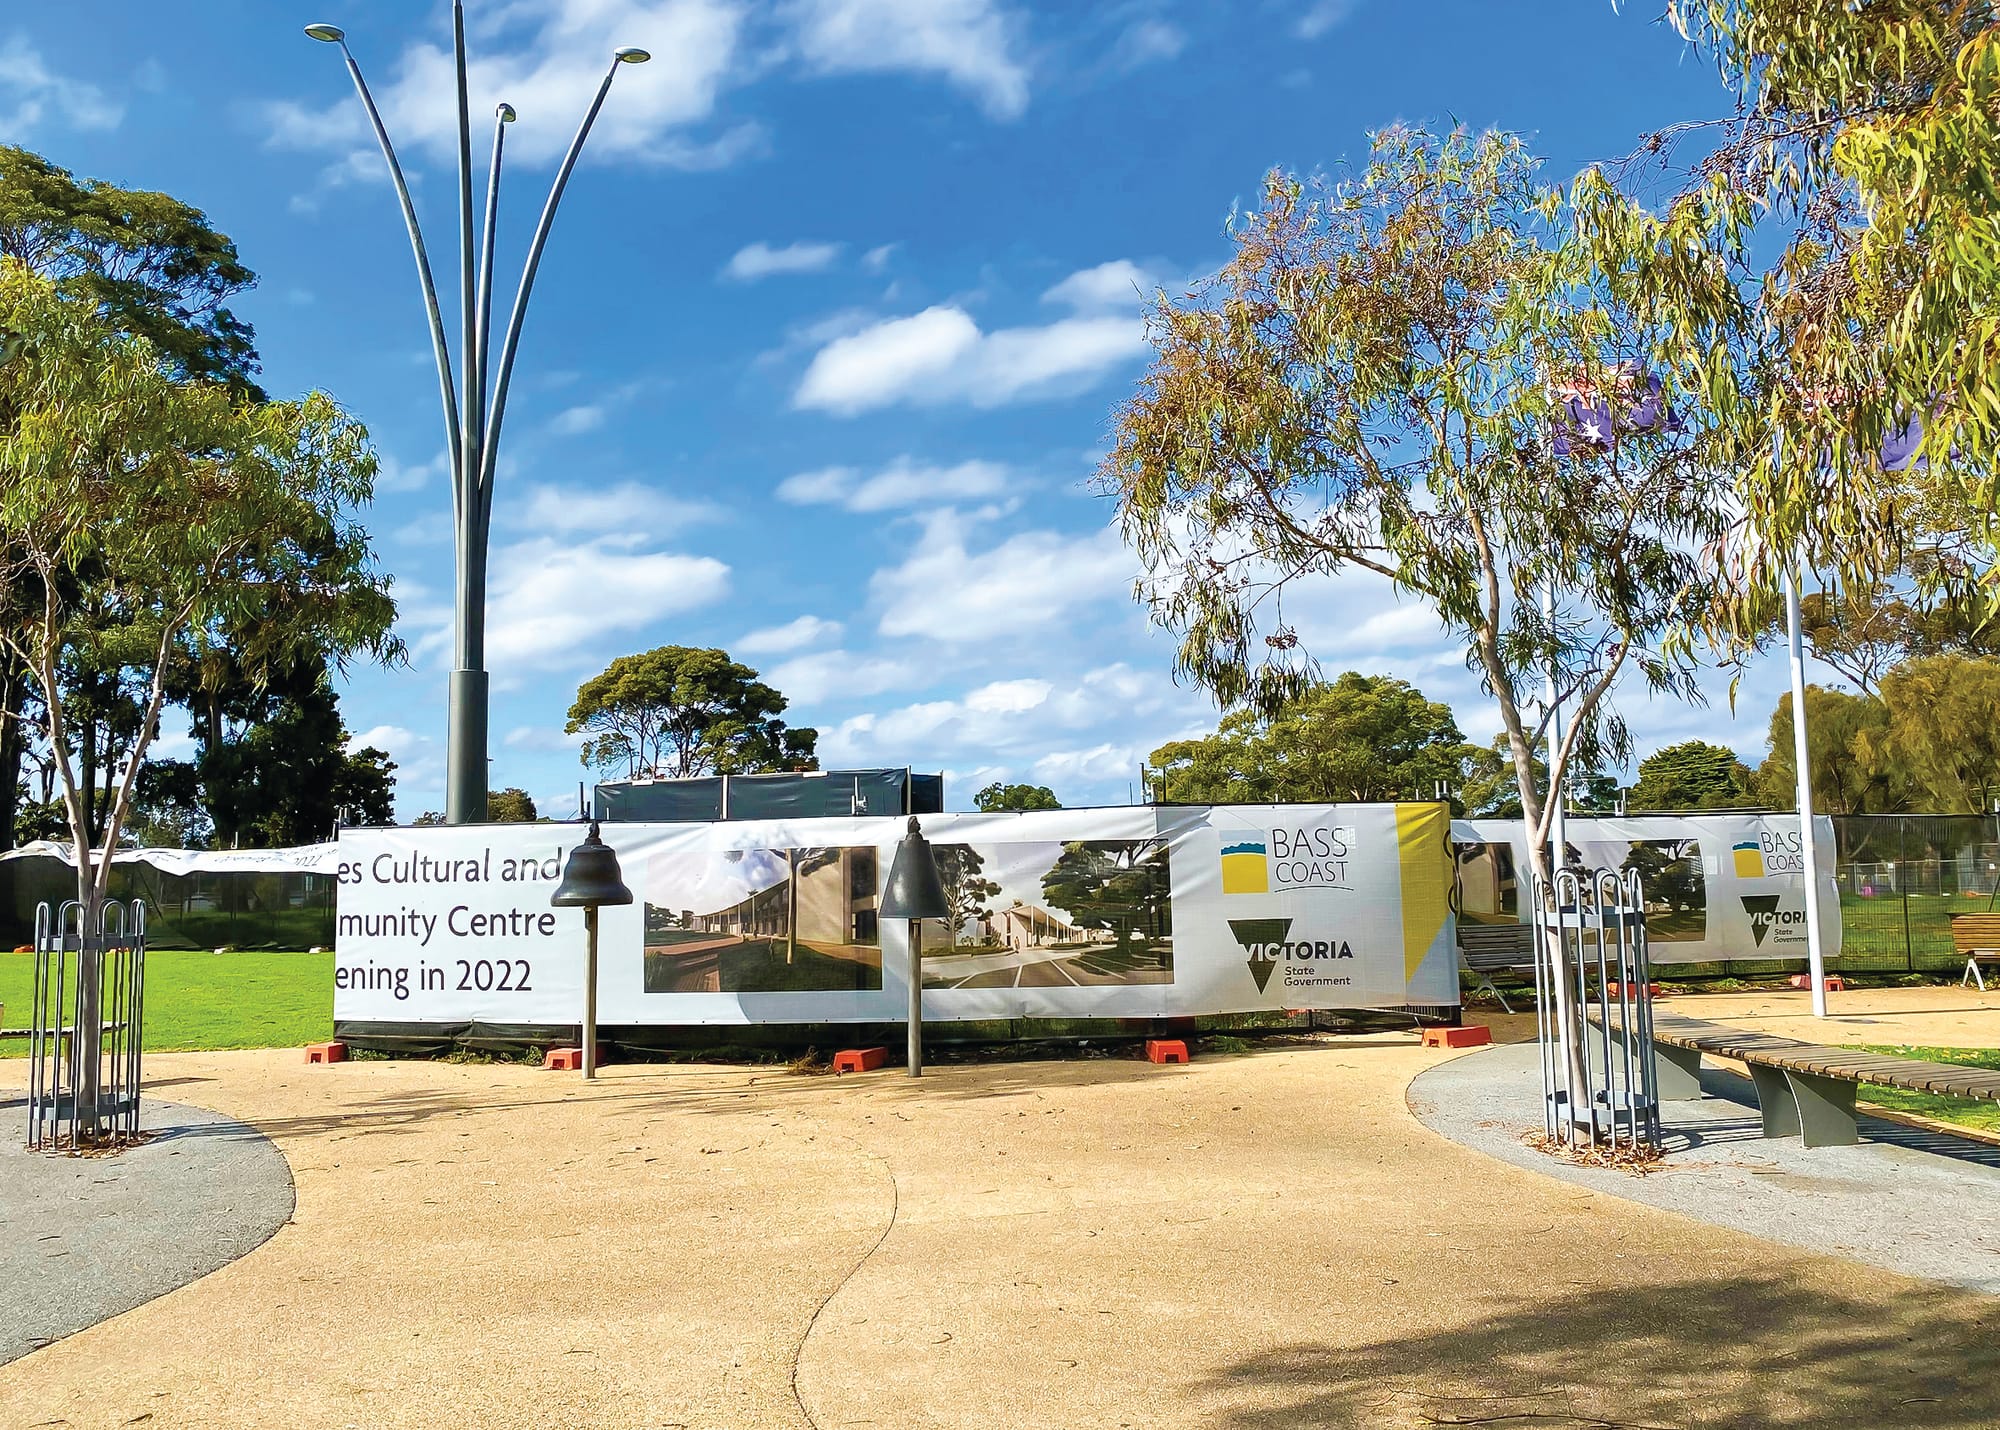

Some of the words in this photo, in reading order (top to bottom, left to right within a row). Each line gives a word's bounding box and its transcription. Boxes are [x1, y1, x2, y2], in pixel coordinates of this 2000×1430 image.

[1272, 828, 1348, 859] BASS
[1760, 832, 1803, 853] BAS
[337, 862, 362, 884] es
[372, 848, 489, 884] Cultural
[502, 847, 562, 881] and
[1275, 861, 1349, 883] COAST
[1766, 855, 1804, 871] COAS
[339, 906, 437, 946] munity
[448, 905, 556, 937] Centre
[1747, 911, 1807, 926] VICTORI
[1773, 936, 1808, 944] Governme
[1244, 940, 1354, 963] VICTORIA
[335, 959, 410, 1000] ening
[420, 959, 445, 990] in
[456, 959, 533, 991] 2022
[1284, 976, 1351, 987] Government
[1285, 966, 1315, 976] State
